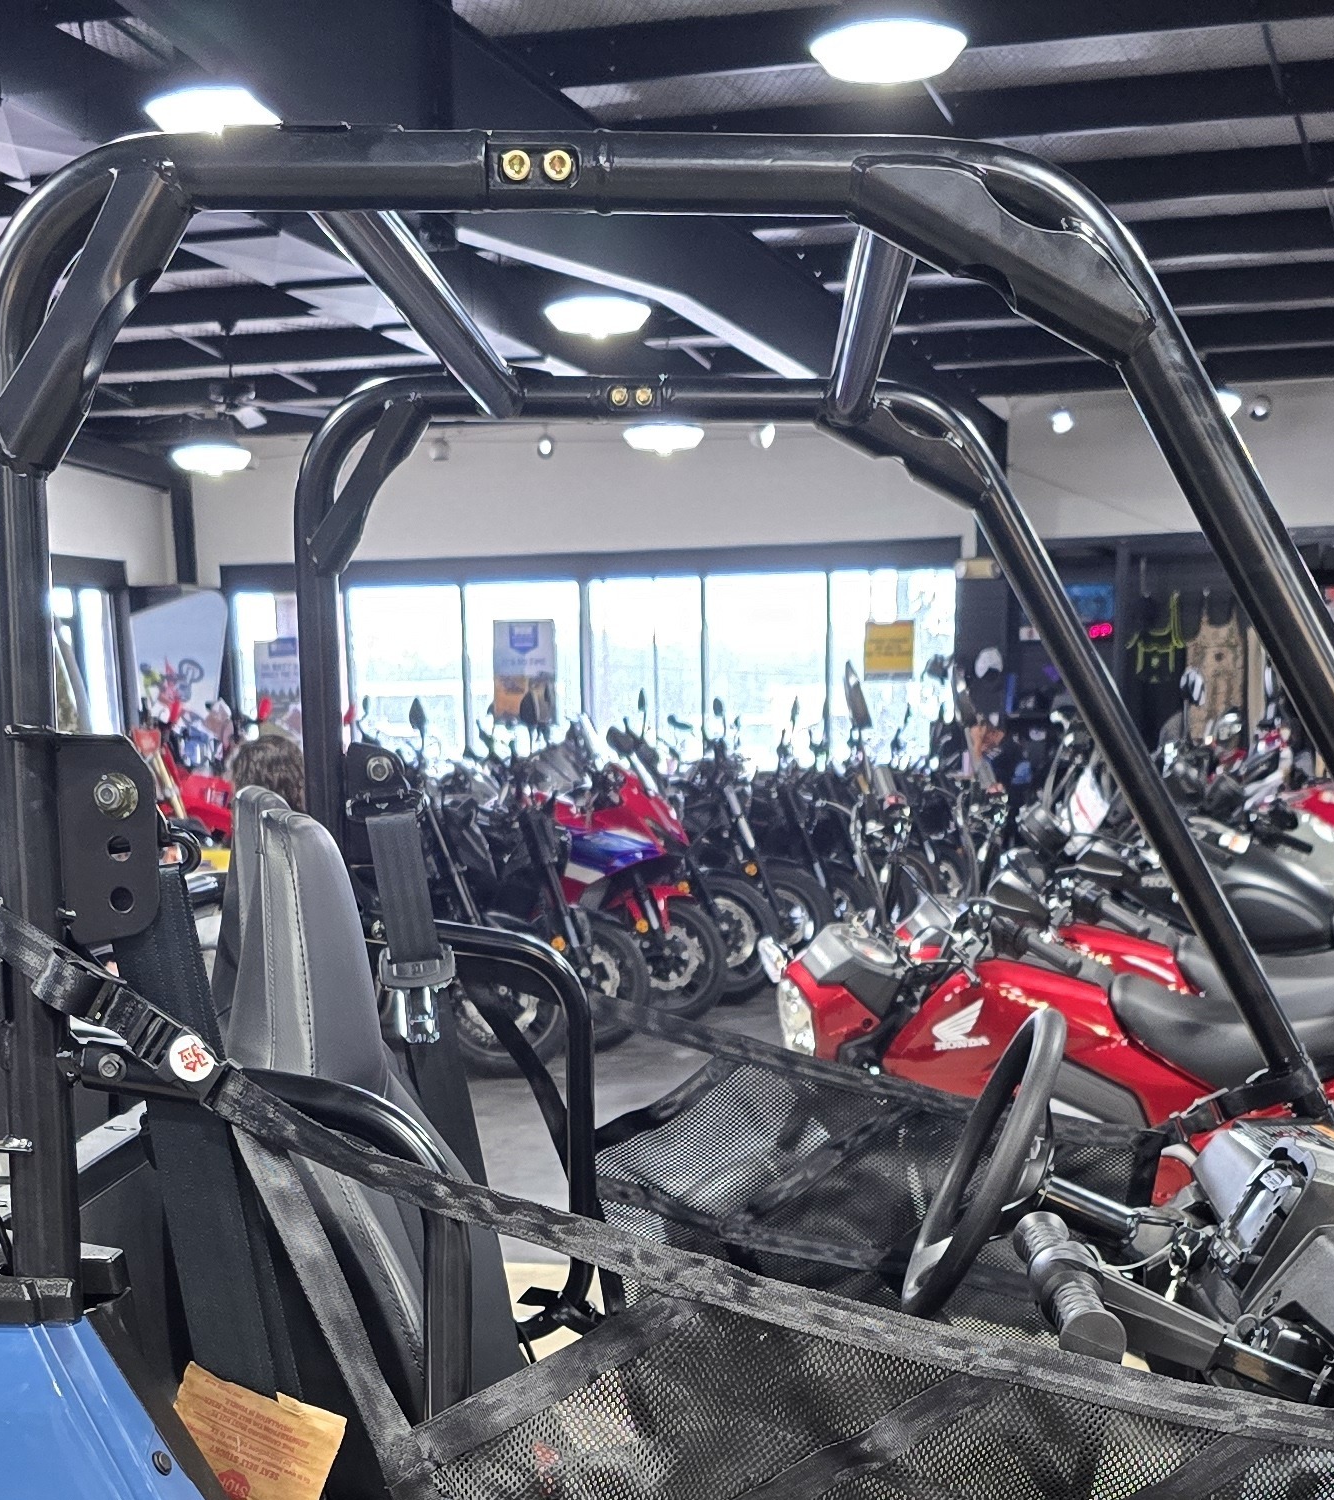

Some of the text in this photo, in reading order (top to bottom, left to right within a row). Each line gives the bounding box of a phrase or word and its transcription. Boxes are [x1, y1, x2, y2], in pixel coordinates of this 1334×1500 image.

[933, 1036, 991, 1051] HONDA
[209, 1444, 280, 1481] SEAT BELT STUCK?
